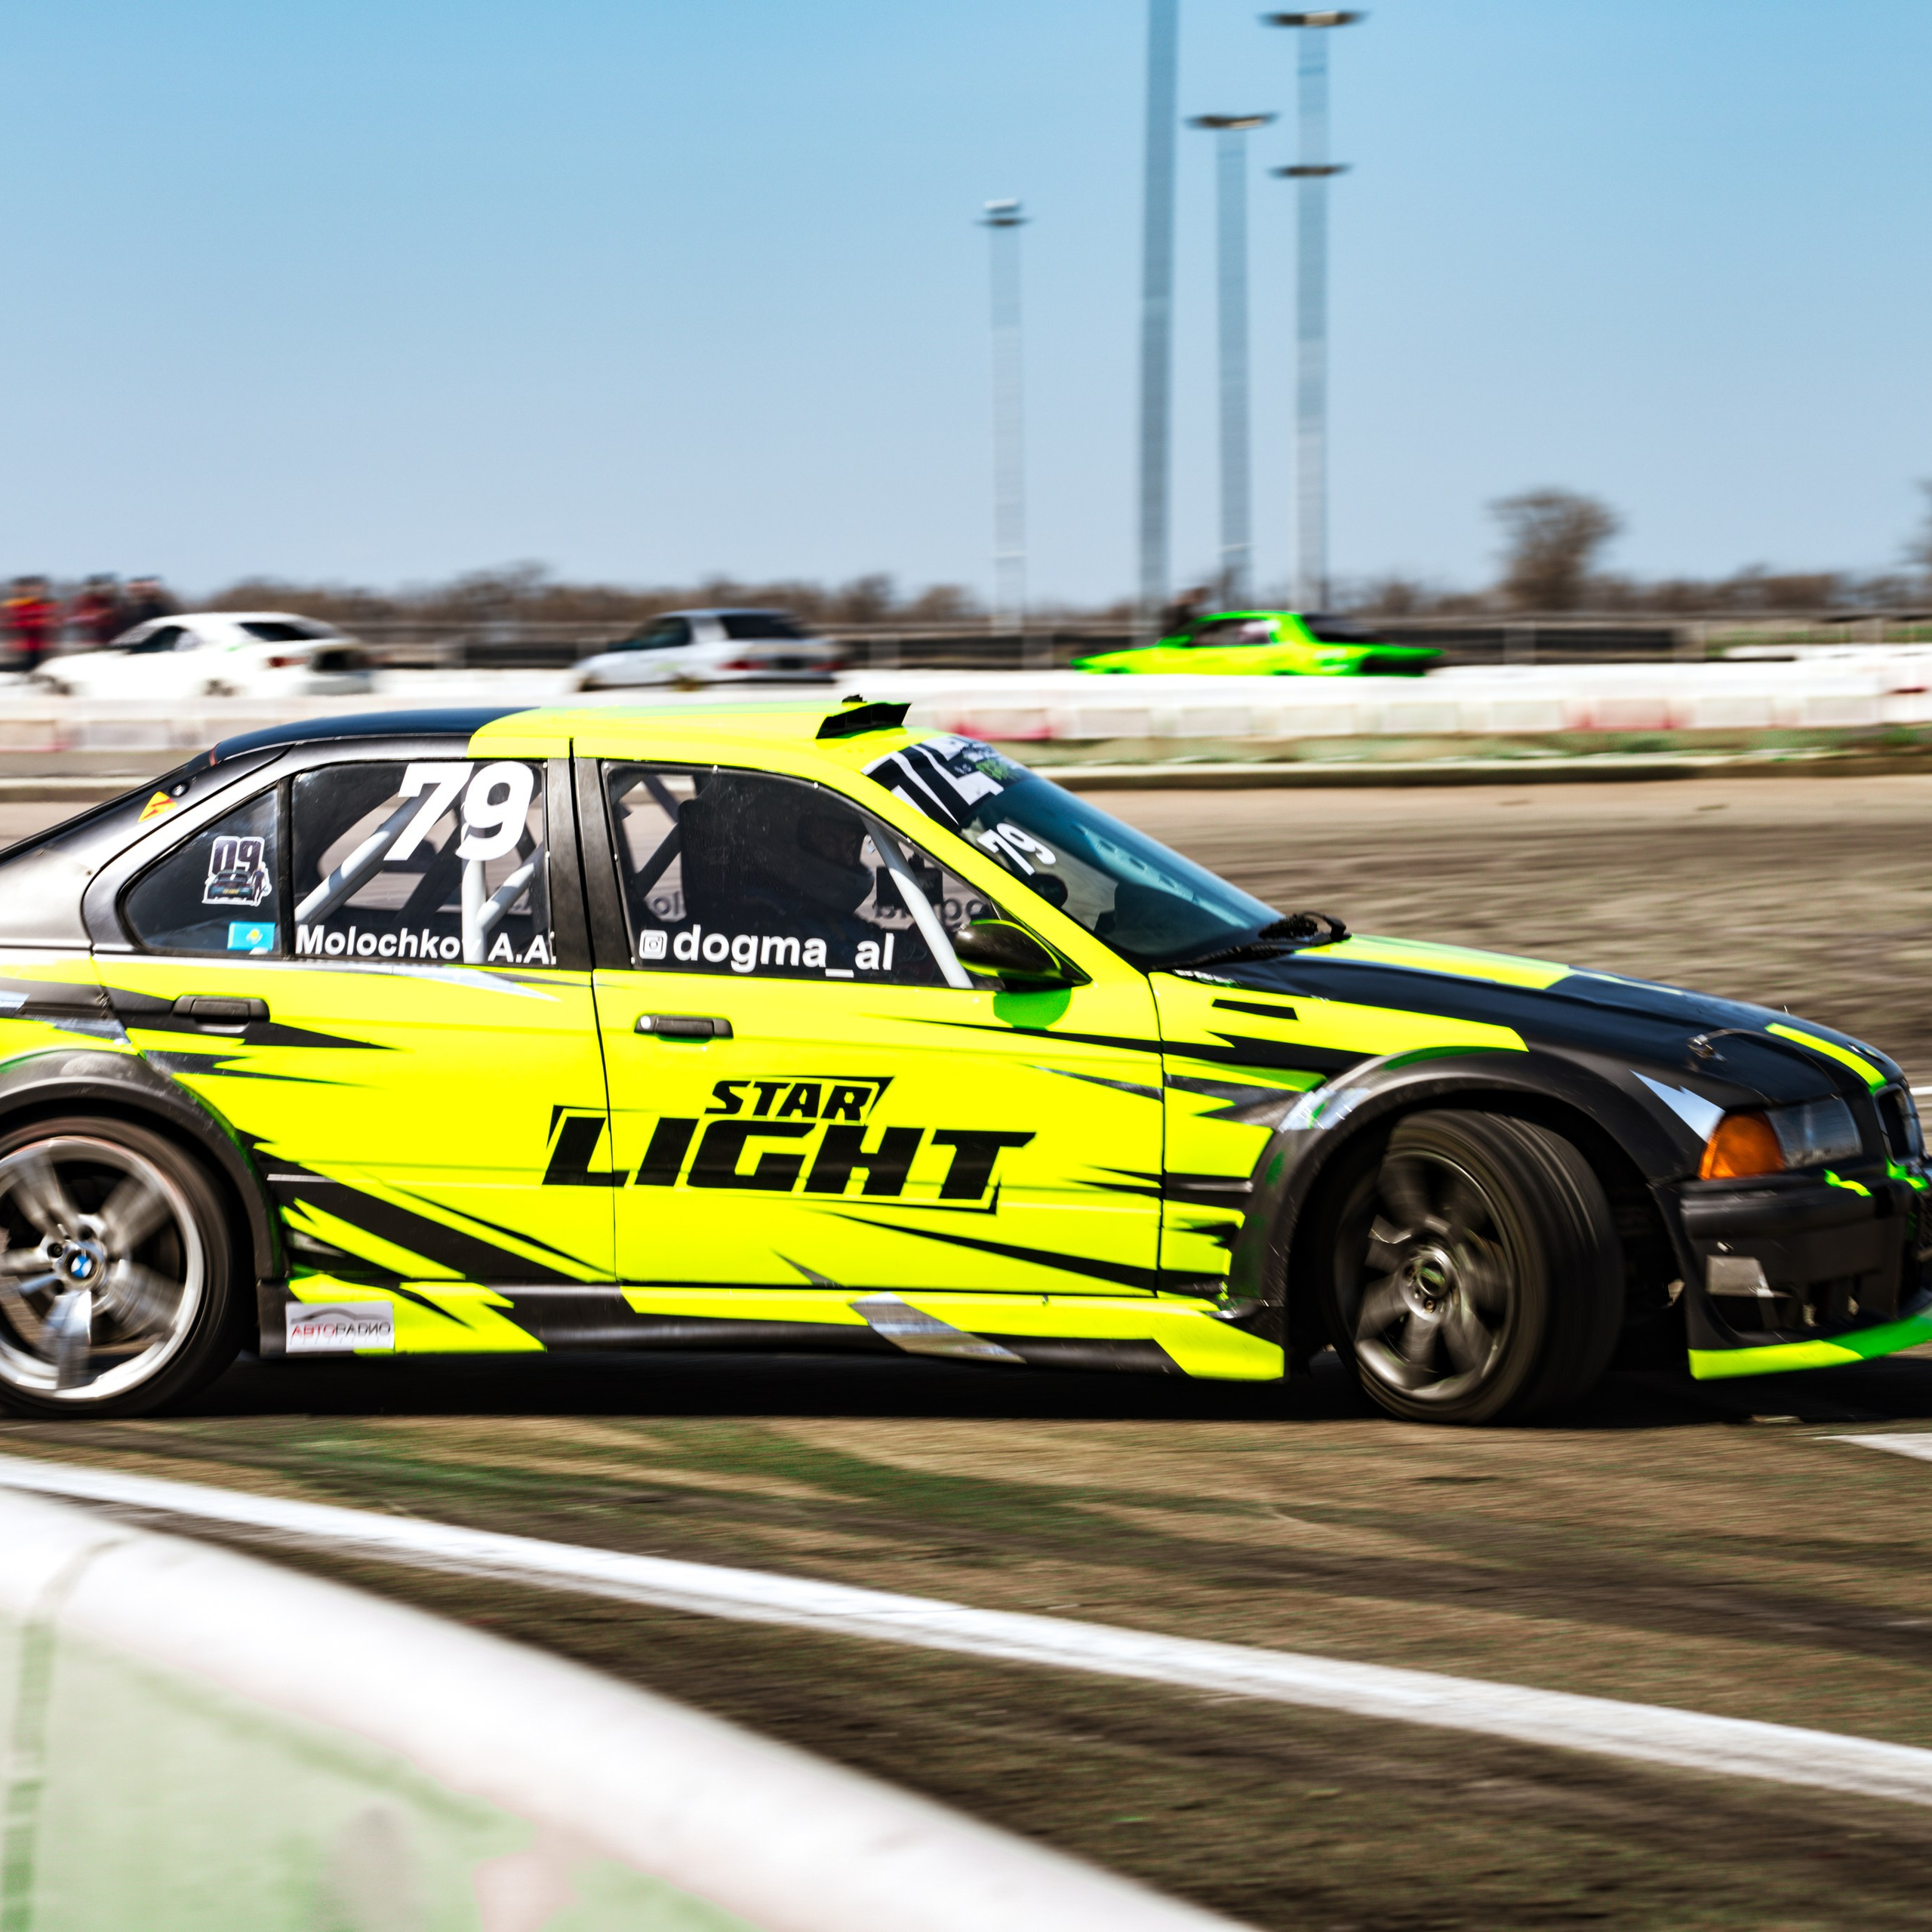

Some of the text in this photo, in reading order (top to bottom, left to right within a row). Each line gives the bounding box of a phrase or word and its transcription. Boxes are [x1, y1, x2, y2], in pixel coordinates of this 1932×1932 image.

[384, 761, 534, 860] 79
[212, 839, 262, 875] 09
[977, 823, 1057, 876] 79
[672, 924, 894, 978] dogma_al
[704, 1080, 874, 1121] STAR
[542, 1117, 1036, 1200] LIGHT
